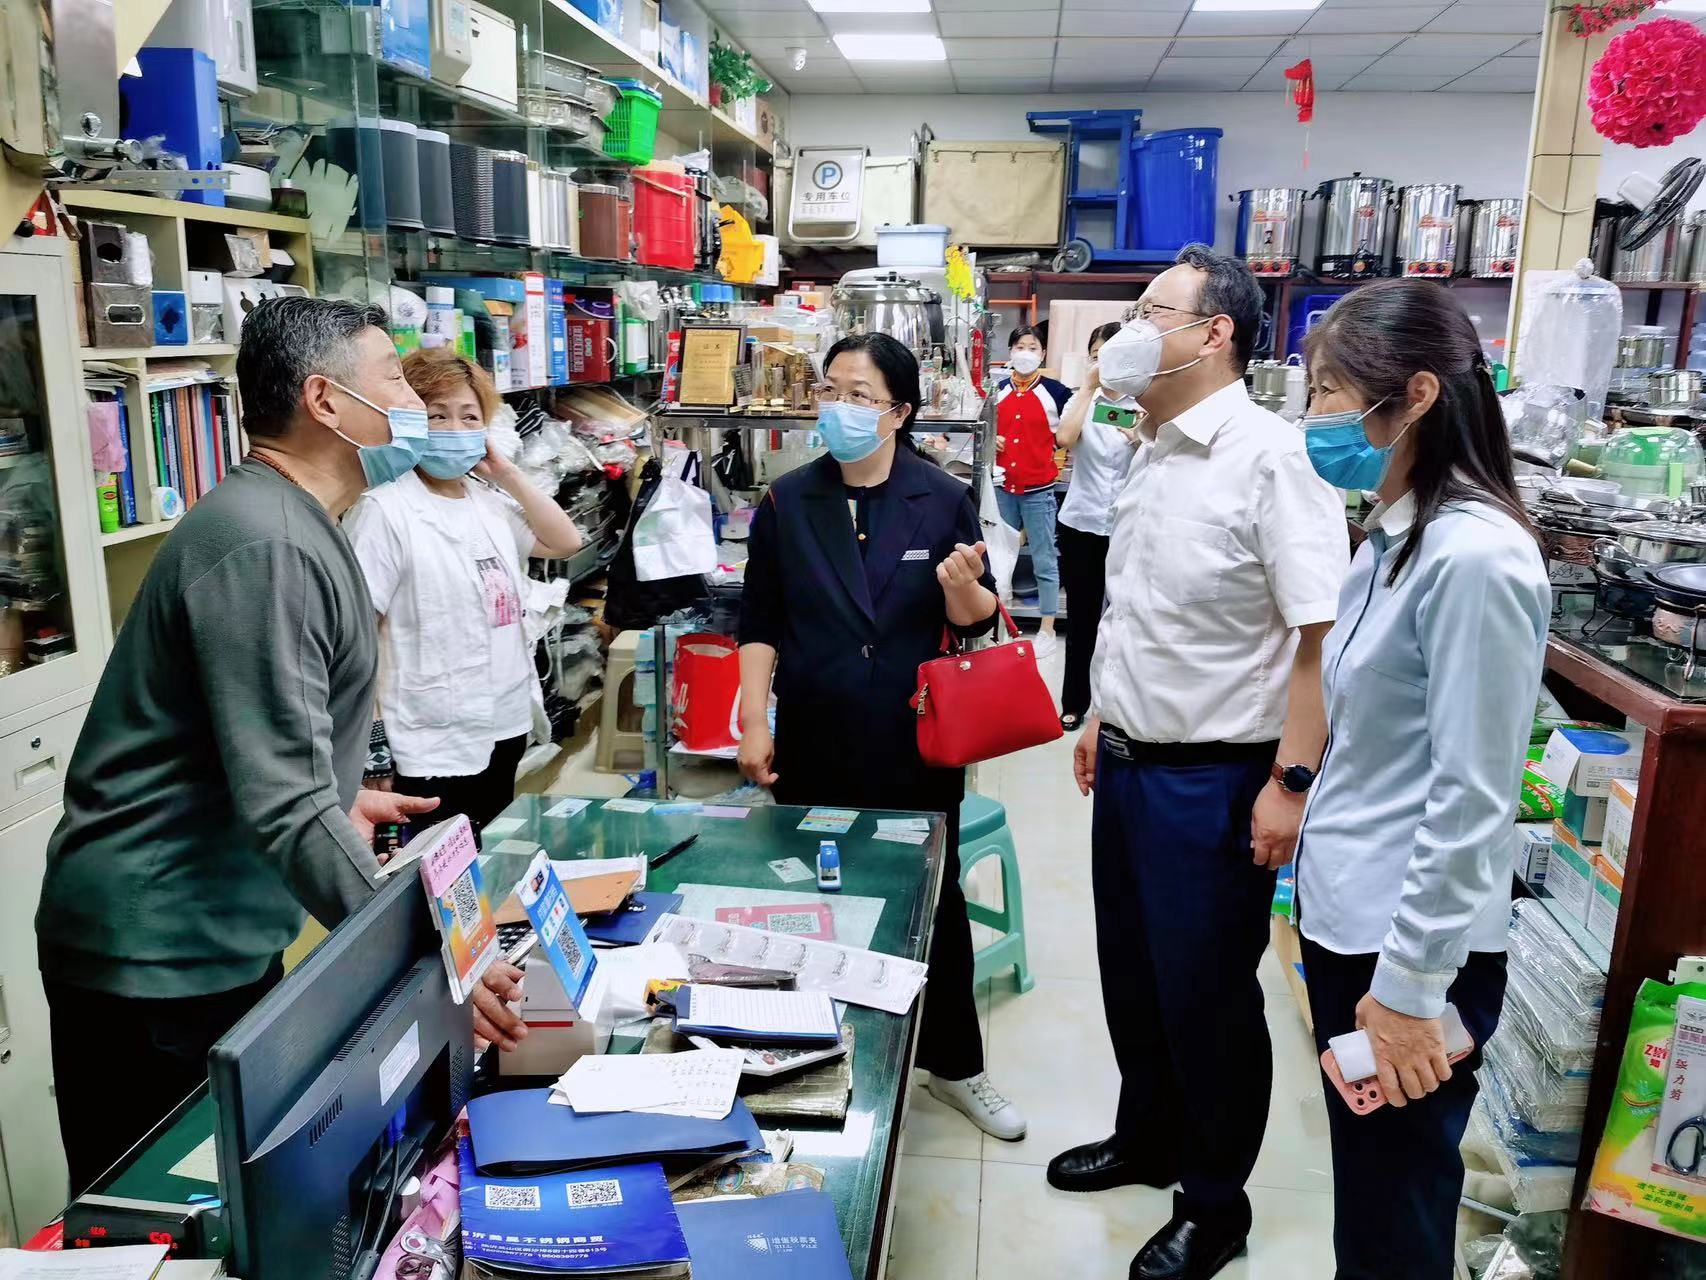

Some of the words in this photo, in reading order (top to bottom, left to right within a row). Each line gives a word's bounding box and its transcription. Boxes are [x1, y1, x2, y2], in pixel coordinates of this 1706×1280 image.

[821, 167, 837, 185] P
[803, 191, 850, 201] 专用车位
